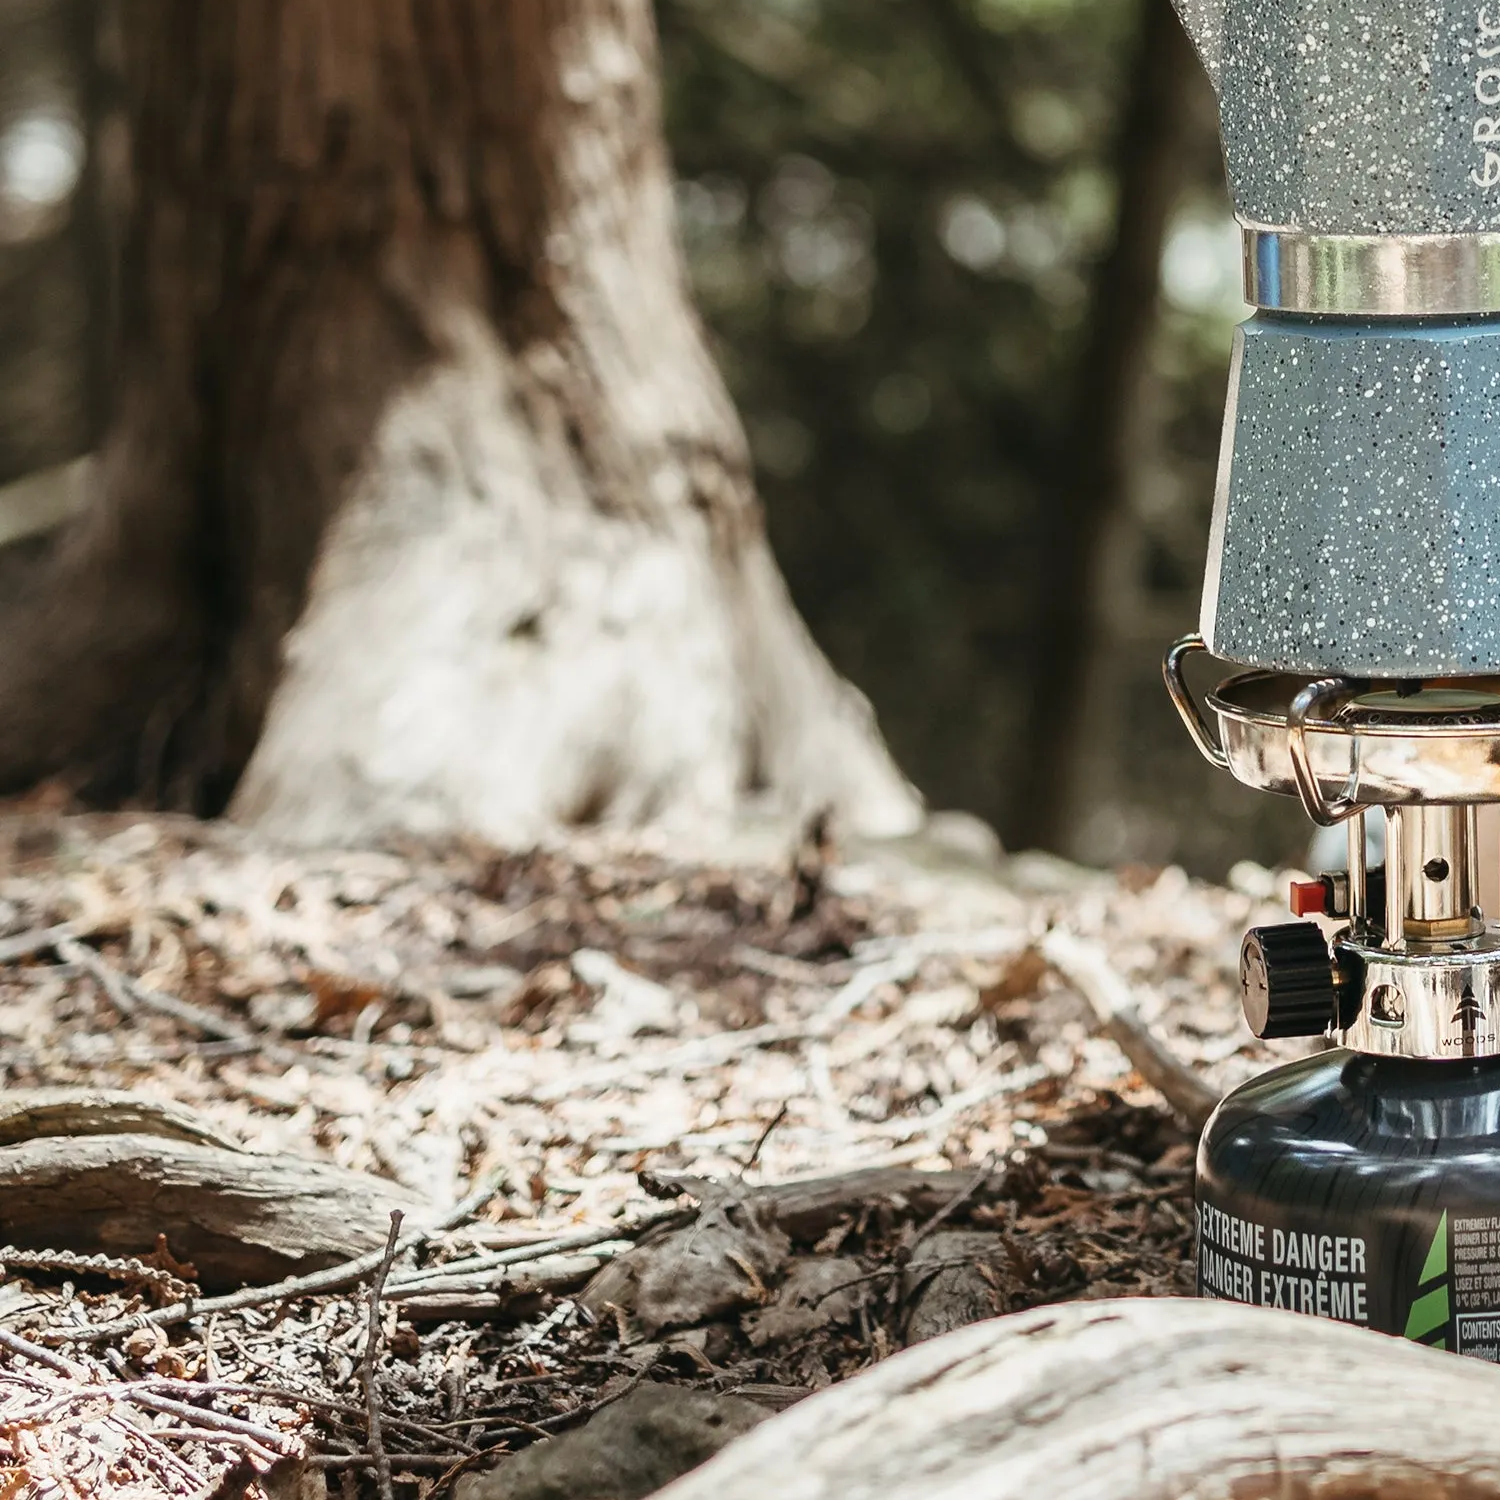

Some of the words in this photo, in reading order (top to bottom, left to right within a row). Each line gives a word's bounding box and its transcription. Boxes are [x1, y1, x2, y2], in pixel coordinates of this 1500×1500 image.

[1442, 1033, 1495, 1046] WOODS
[1454, 1218, 1491, 1230] EXTREMELY
[1202, 1200, 1265, 1262] EXTREME
[1272, 1228, 1367, 1274] DANGER
[1455, 1233, 1481, 1245] BURNER
[1481, 1232, 1489, 1244] IS
[1489, 1231, 1497, 1243] IN
[1455, 1247, 1488, 1260] PRESSURE
[1489, 1246, 1496, 1258] IS
[1202, 1243, 1253, 1304] DANGER
[1261, 1271, 1368, 1321] EXTRÊME
[1455, 1278, 1473, 1291] LISEZ
[1474, 1277, 1482, 1290] ET
